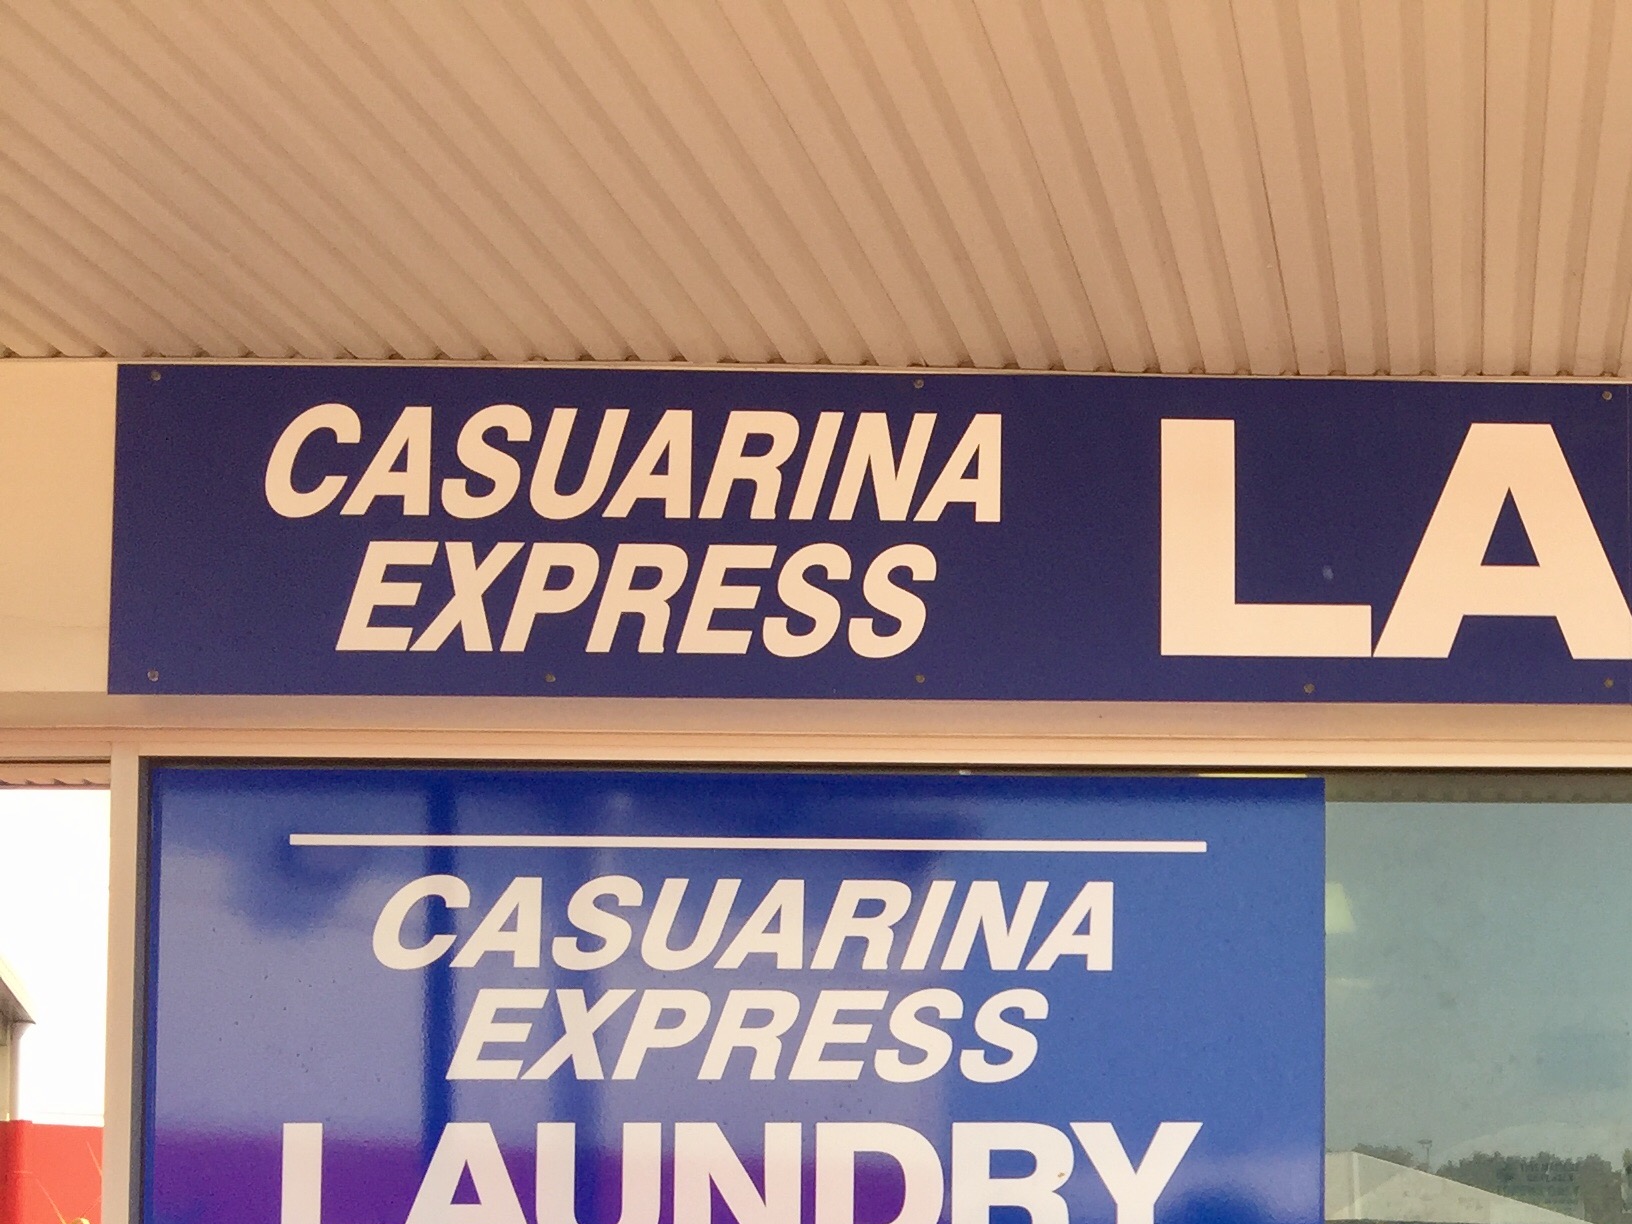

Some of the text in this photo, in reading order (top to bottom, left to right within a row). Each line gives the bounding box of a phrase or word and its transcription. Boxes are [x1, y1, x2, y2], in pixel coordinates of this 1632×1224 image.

[266, 404, 1001, 522] CASUARINA
[336, 541, 936, 658] EXPRESS
[373, 876, 1113, 970] CASUARINA
[447, 989, 1048, 1082] EXPRESS
